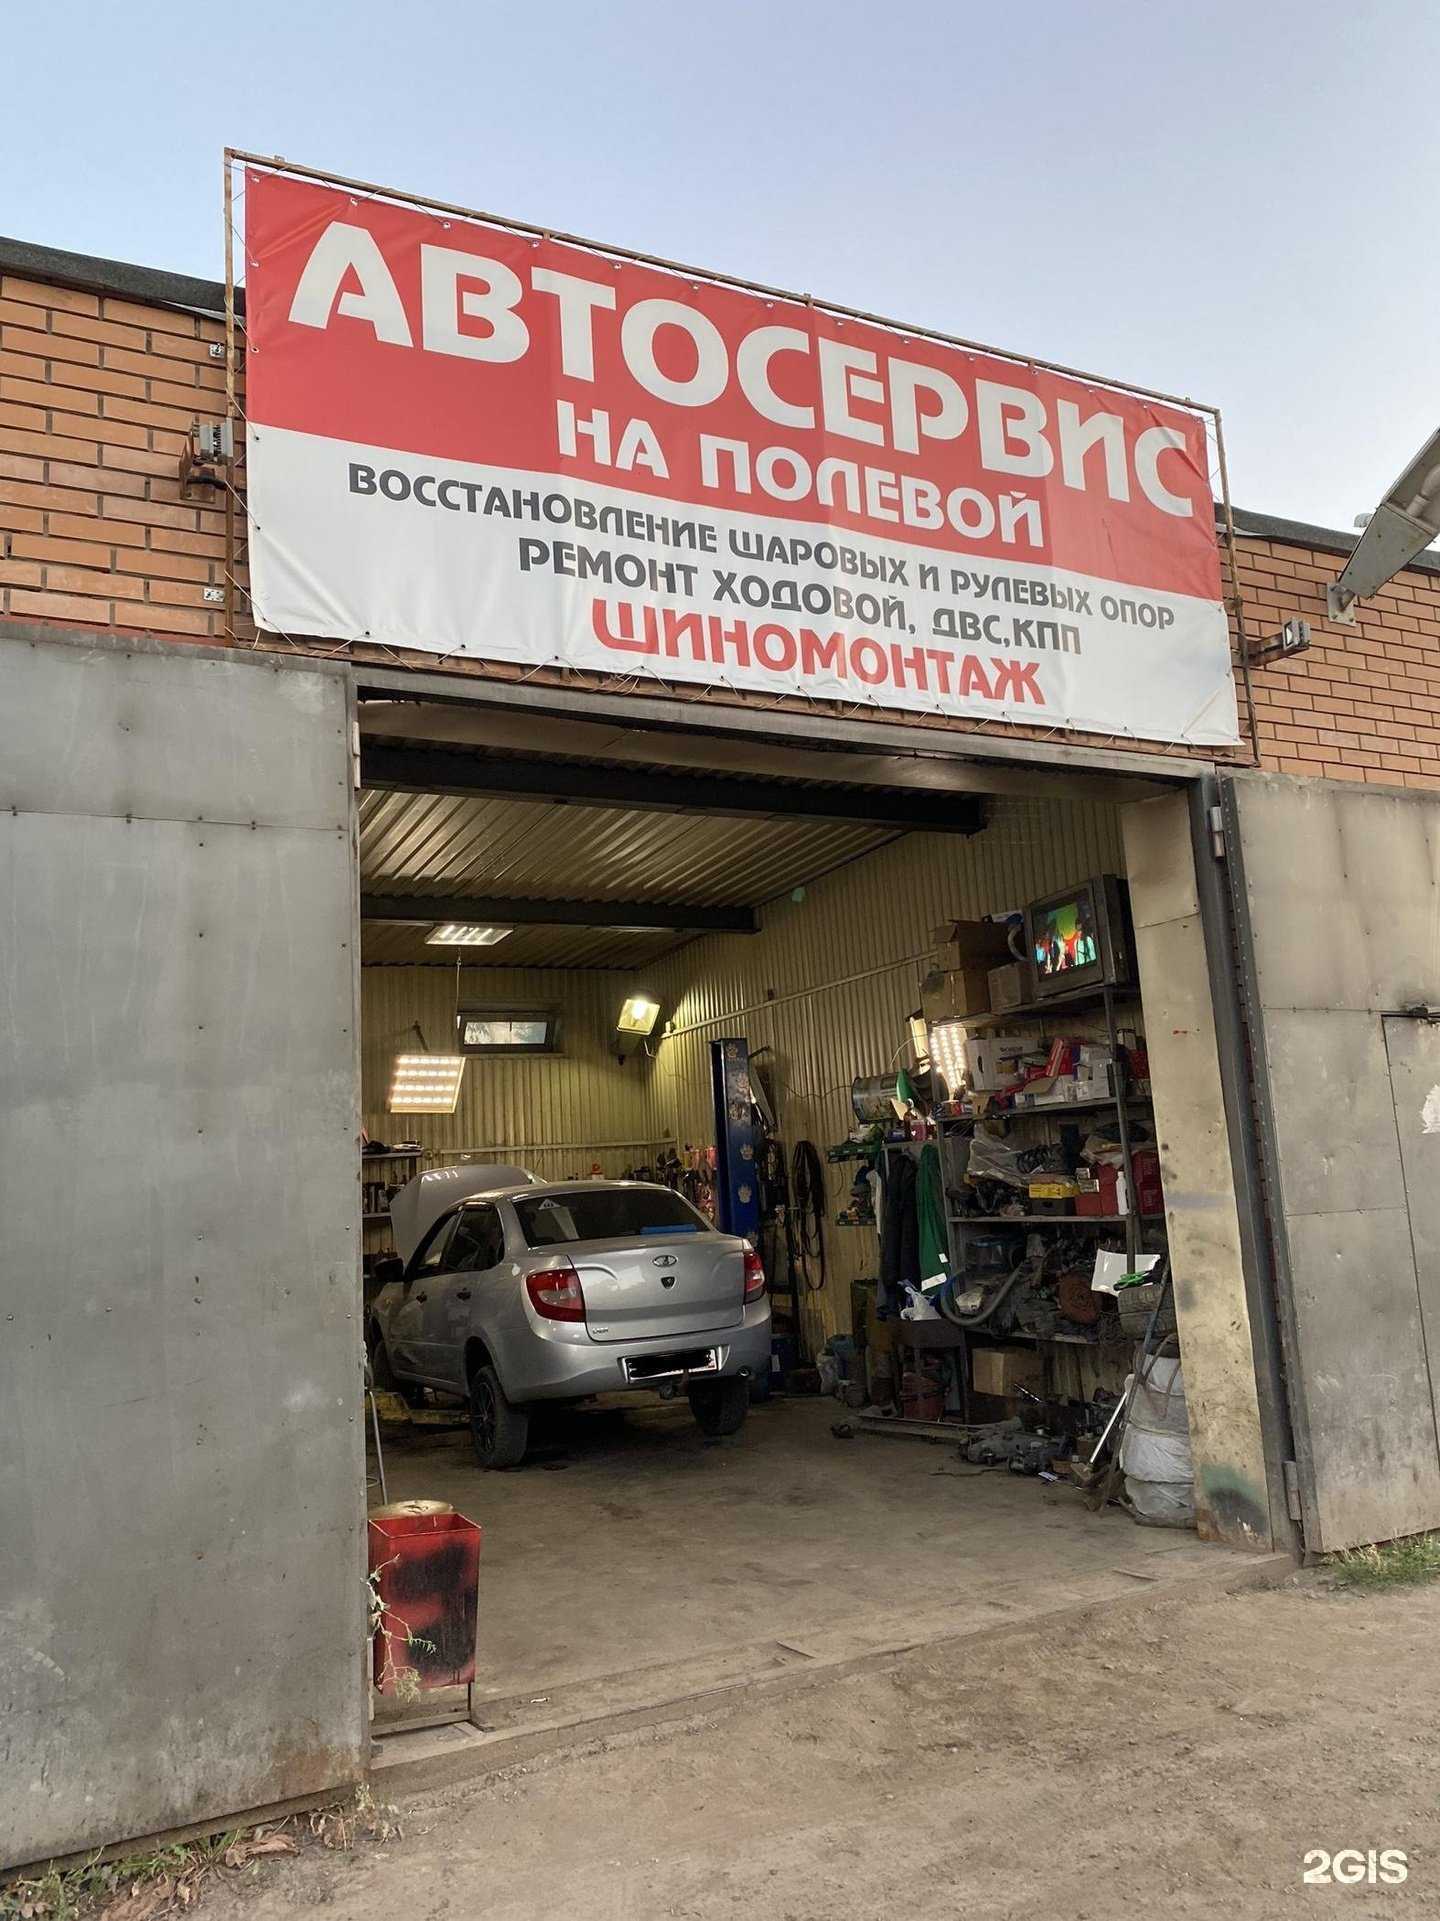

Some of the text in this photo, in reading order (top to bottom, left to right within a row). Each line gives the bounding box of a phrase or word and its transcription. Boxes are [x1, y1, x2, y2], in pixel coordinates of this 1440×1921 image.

[288, 221, 1194, 518] АВТОСЕРВИС
[348, 463, 1175, 630] ВОССТАНОВЛЕНИЕ ШАРОВЫХ И РУЛЕВЫХ ОПОР
[556, 399, 1044, 548] НА ПОЛЕВОЙ
[518, 537, 699, 596] РЕМОНТ
[712, 568, 916, 636] ХОДОВОЙ,
[592, 599, 1046, 706] ШИНОМОНТАЖ
